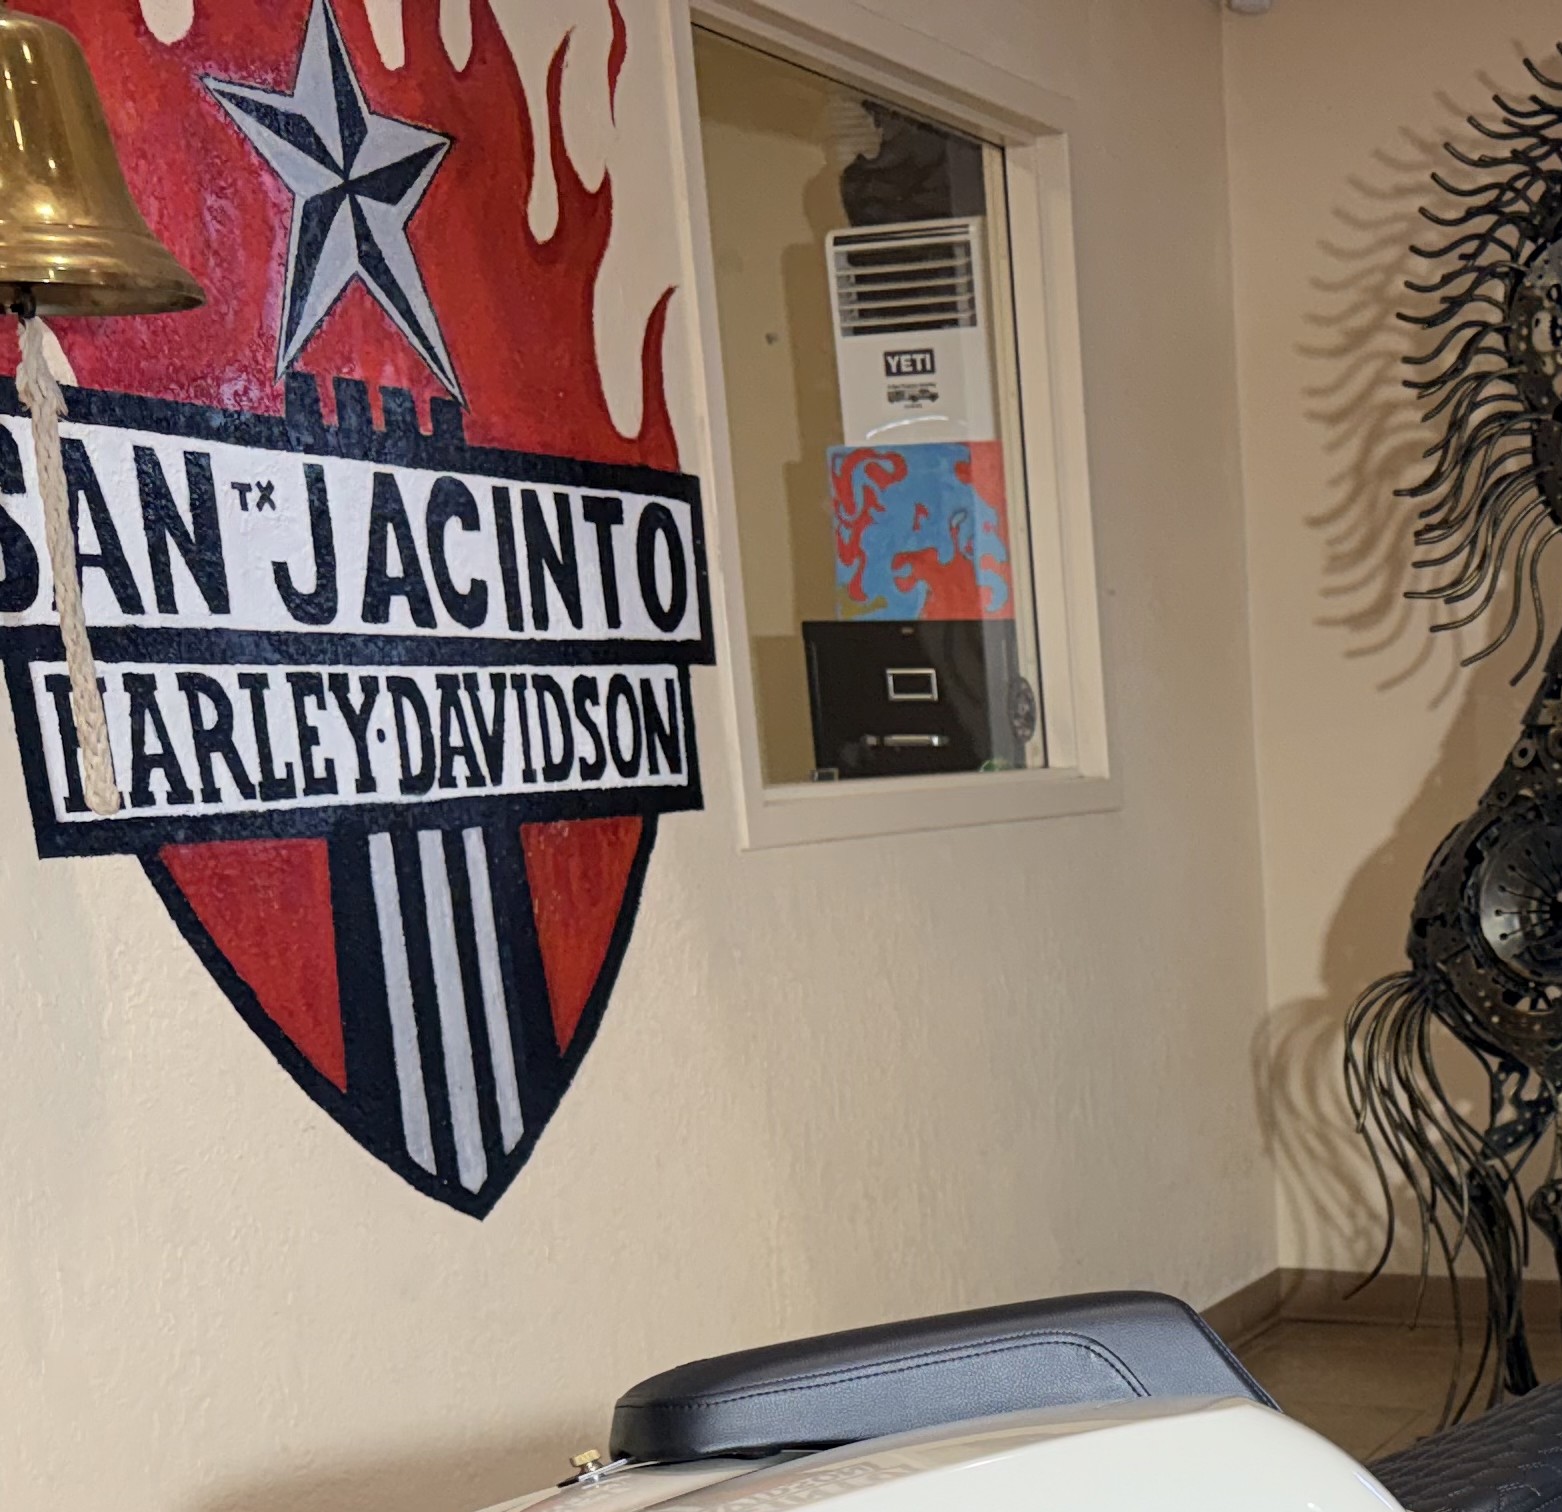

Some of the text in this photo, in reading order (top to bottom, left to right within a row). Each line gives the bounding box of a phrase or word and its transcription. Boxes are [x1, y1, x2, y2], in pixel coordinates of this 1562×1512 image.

[886, 352, 932, 374] YETI
[230, 480, 276, 513] TX
[272, 463, 688, 633] JACINTO
